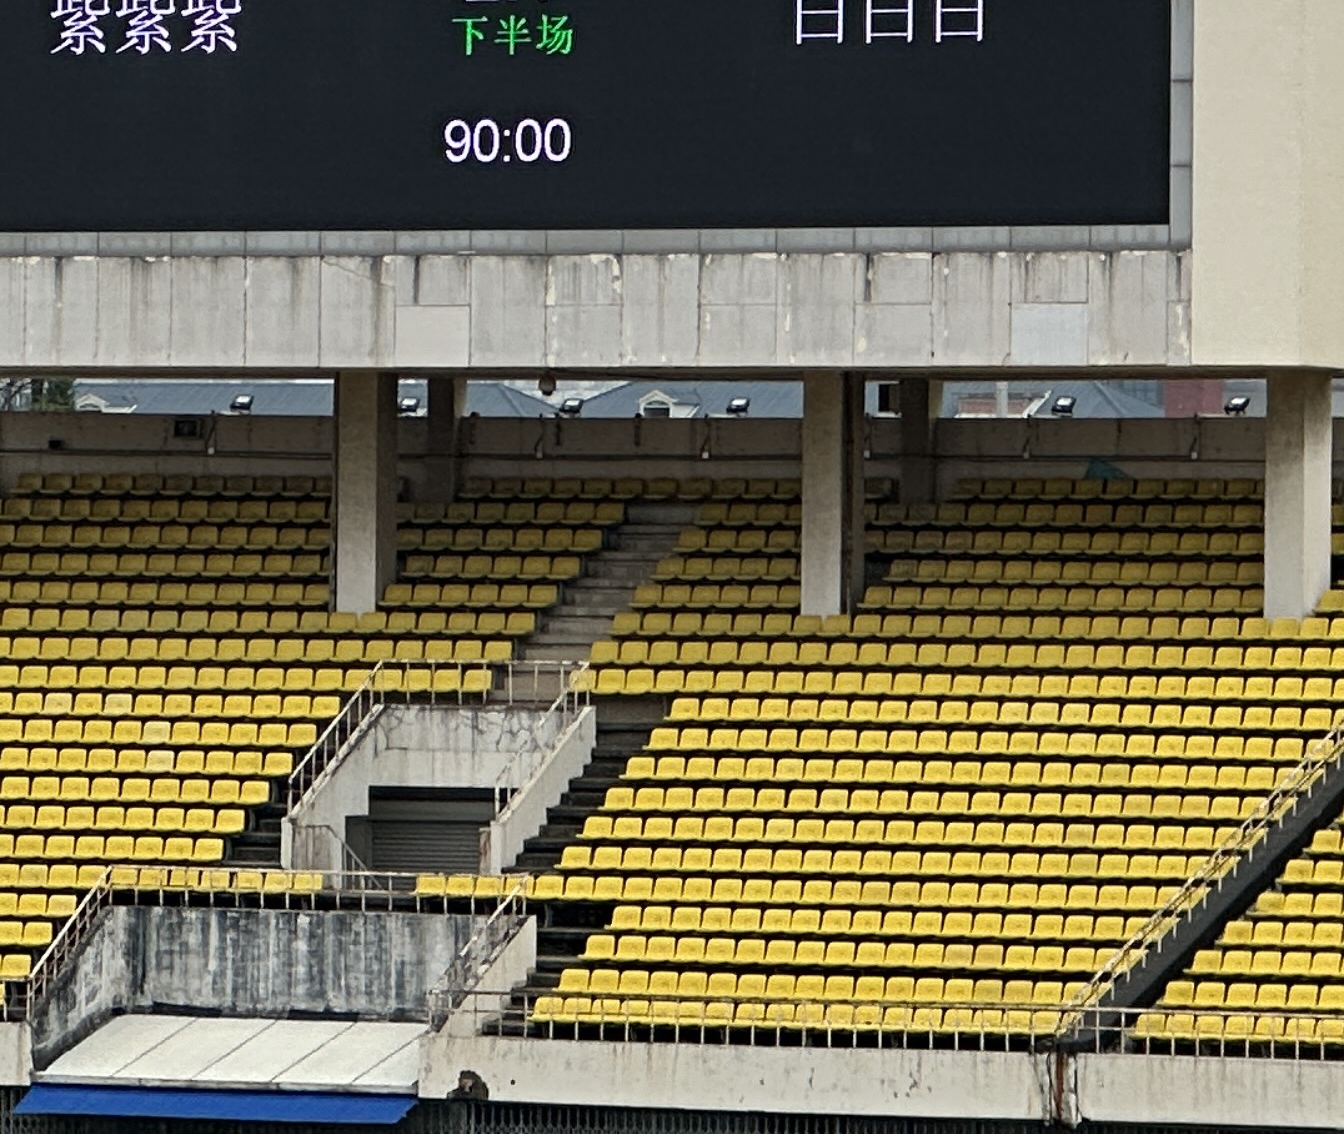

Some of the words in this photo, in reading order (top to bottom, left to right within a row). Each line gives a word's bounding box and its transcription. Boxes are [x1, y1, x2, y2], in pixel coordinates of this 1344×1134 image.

[451, 14, 573, 56] 下半场
[444, 118, 572, 163] 90:00
